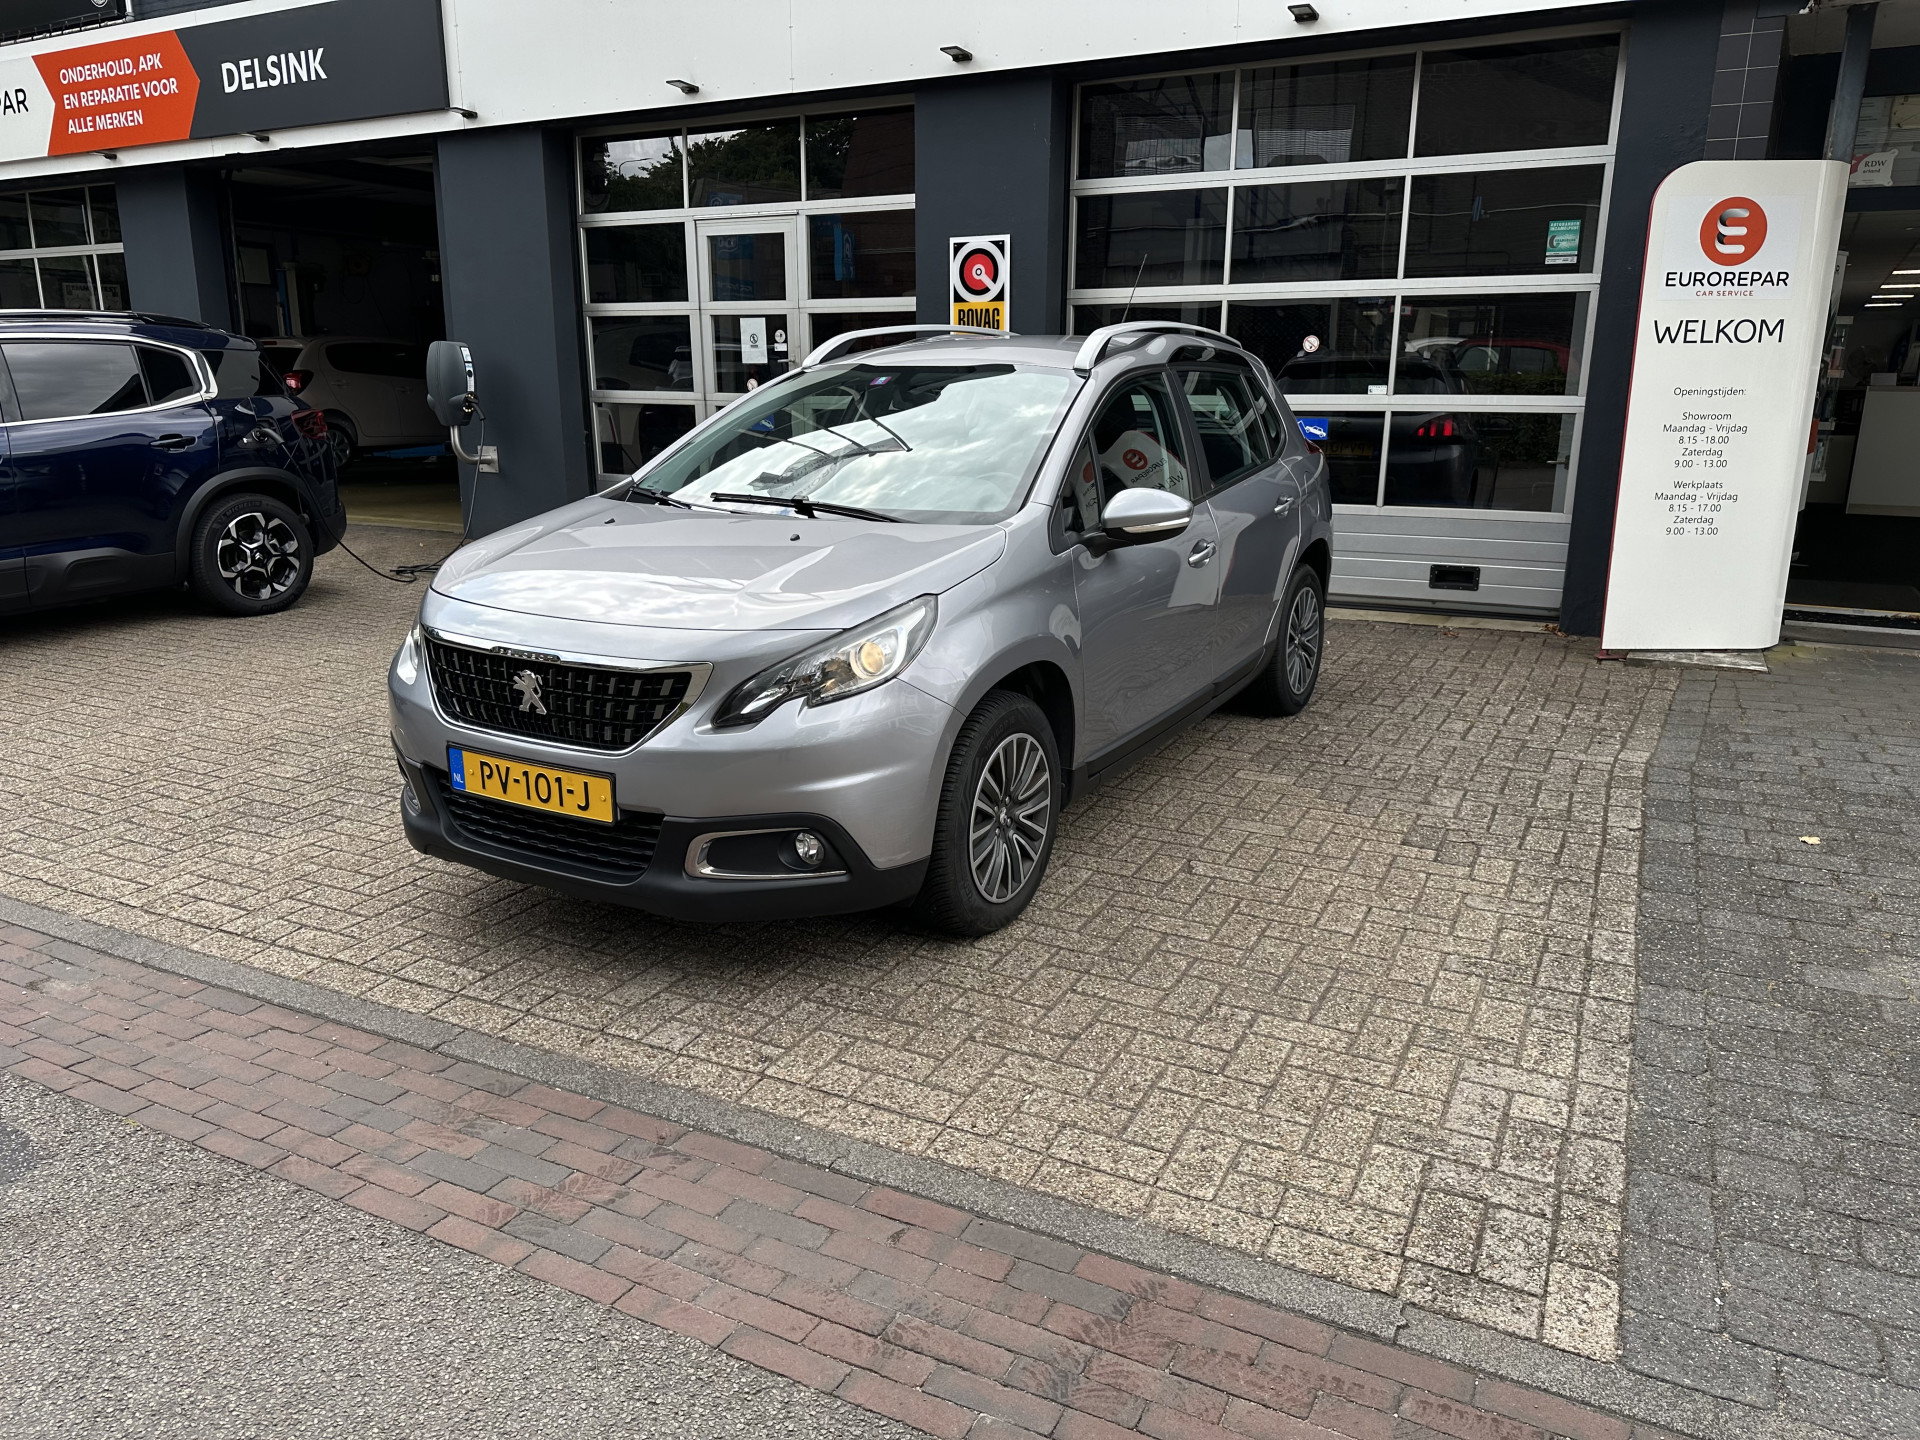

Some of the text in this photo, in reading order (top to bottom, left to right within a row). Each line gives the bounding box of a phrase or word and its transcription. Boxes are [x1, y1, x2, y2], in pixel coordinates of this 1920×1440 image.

[60, 53, 163, 84] ONDERHOUD, APK
[221, 47, 328, 93] DELSINK
[63, 78, 179, 110] EN REPARATIE VOOR
[0, 88, 29, 116] AR
[68, 110, 143, 134] ALLE MERKEN
[1864, 160, 1888, 168] RDW
[1665, 271, 1790, 287] EUROREPAR
[958, 307, 1000, 330] BOVAG
[1654, 319, 1785, 344] WELKOM
[1673, 387, 1747, 398] Openingstijden:
[1682, 411, 1732, 420] Showroom
[1663, 424, 1706, 434] Maandag
[1716, 424, 1748, 434] Vrijdag
[1678, 435, 1698, 444] 8.15
[1681, 447, 1723, 458] Zaterdag
[1674, 459, 1694, 468] 9.00
[1703, 459, 1728, 468] 13.00
[1673, 480, 1723, 490] Werkplaats
[1655, 492, 1697, 502] Maandag
[1706, 492, 1738, 502] Vrijdag
[1668, 503, 1688, 512] 8.15
[1697, 503, 1722, 512] 17.00
[1673, 515, 1714, 526] Zaterdag
[1665, 527, 1685, 536] 9.00
[1694, 527, 1719, 536] 13.00
[453, 772, 464, 783] NL
[479, 759, 590, 812] PV-101-J
